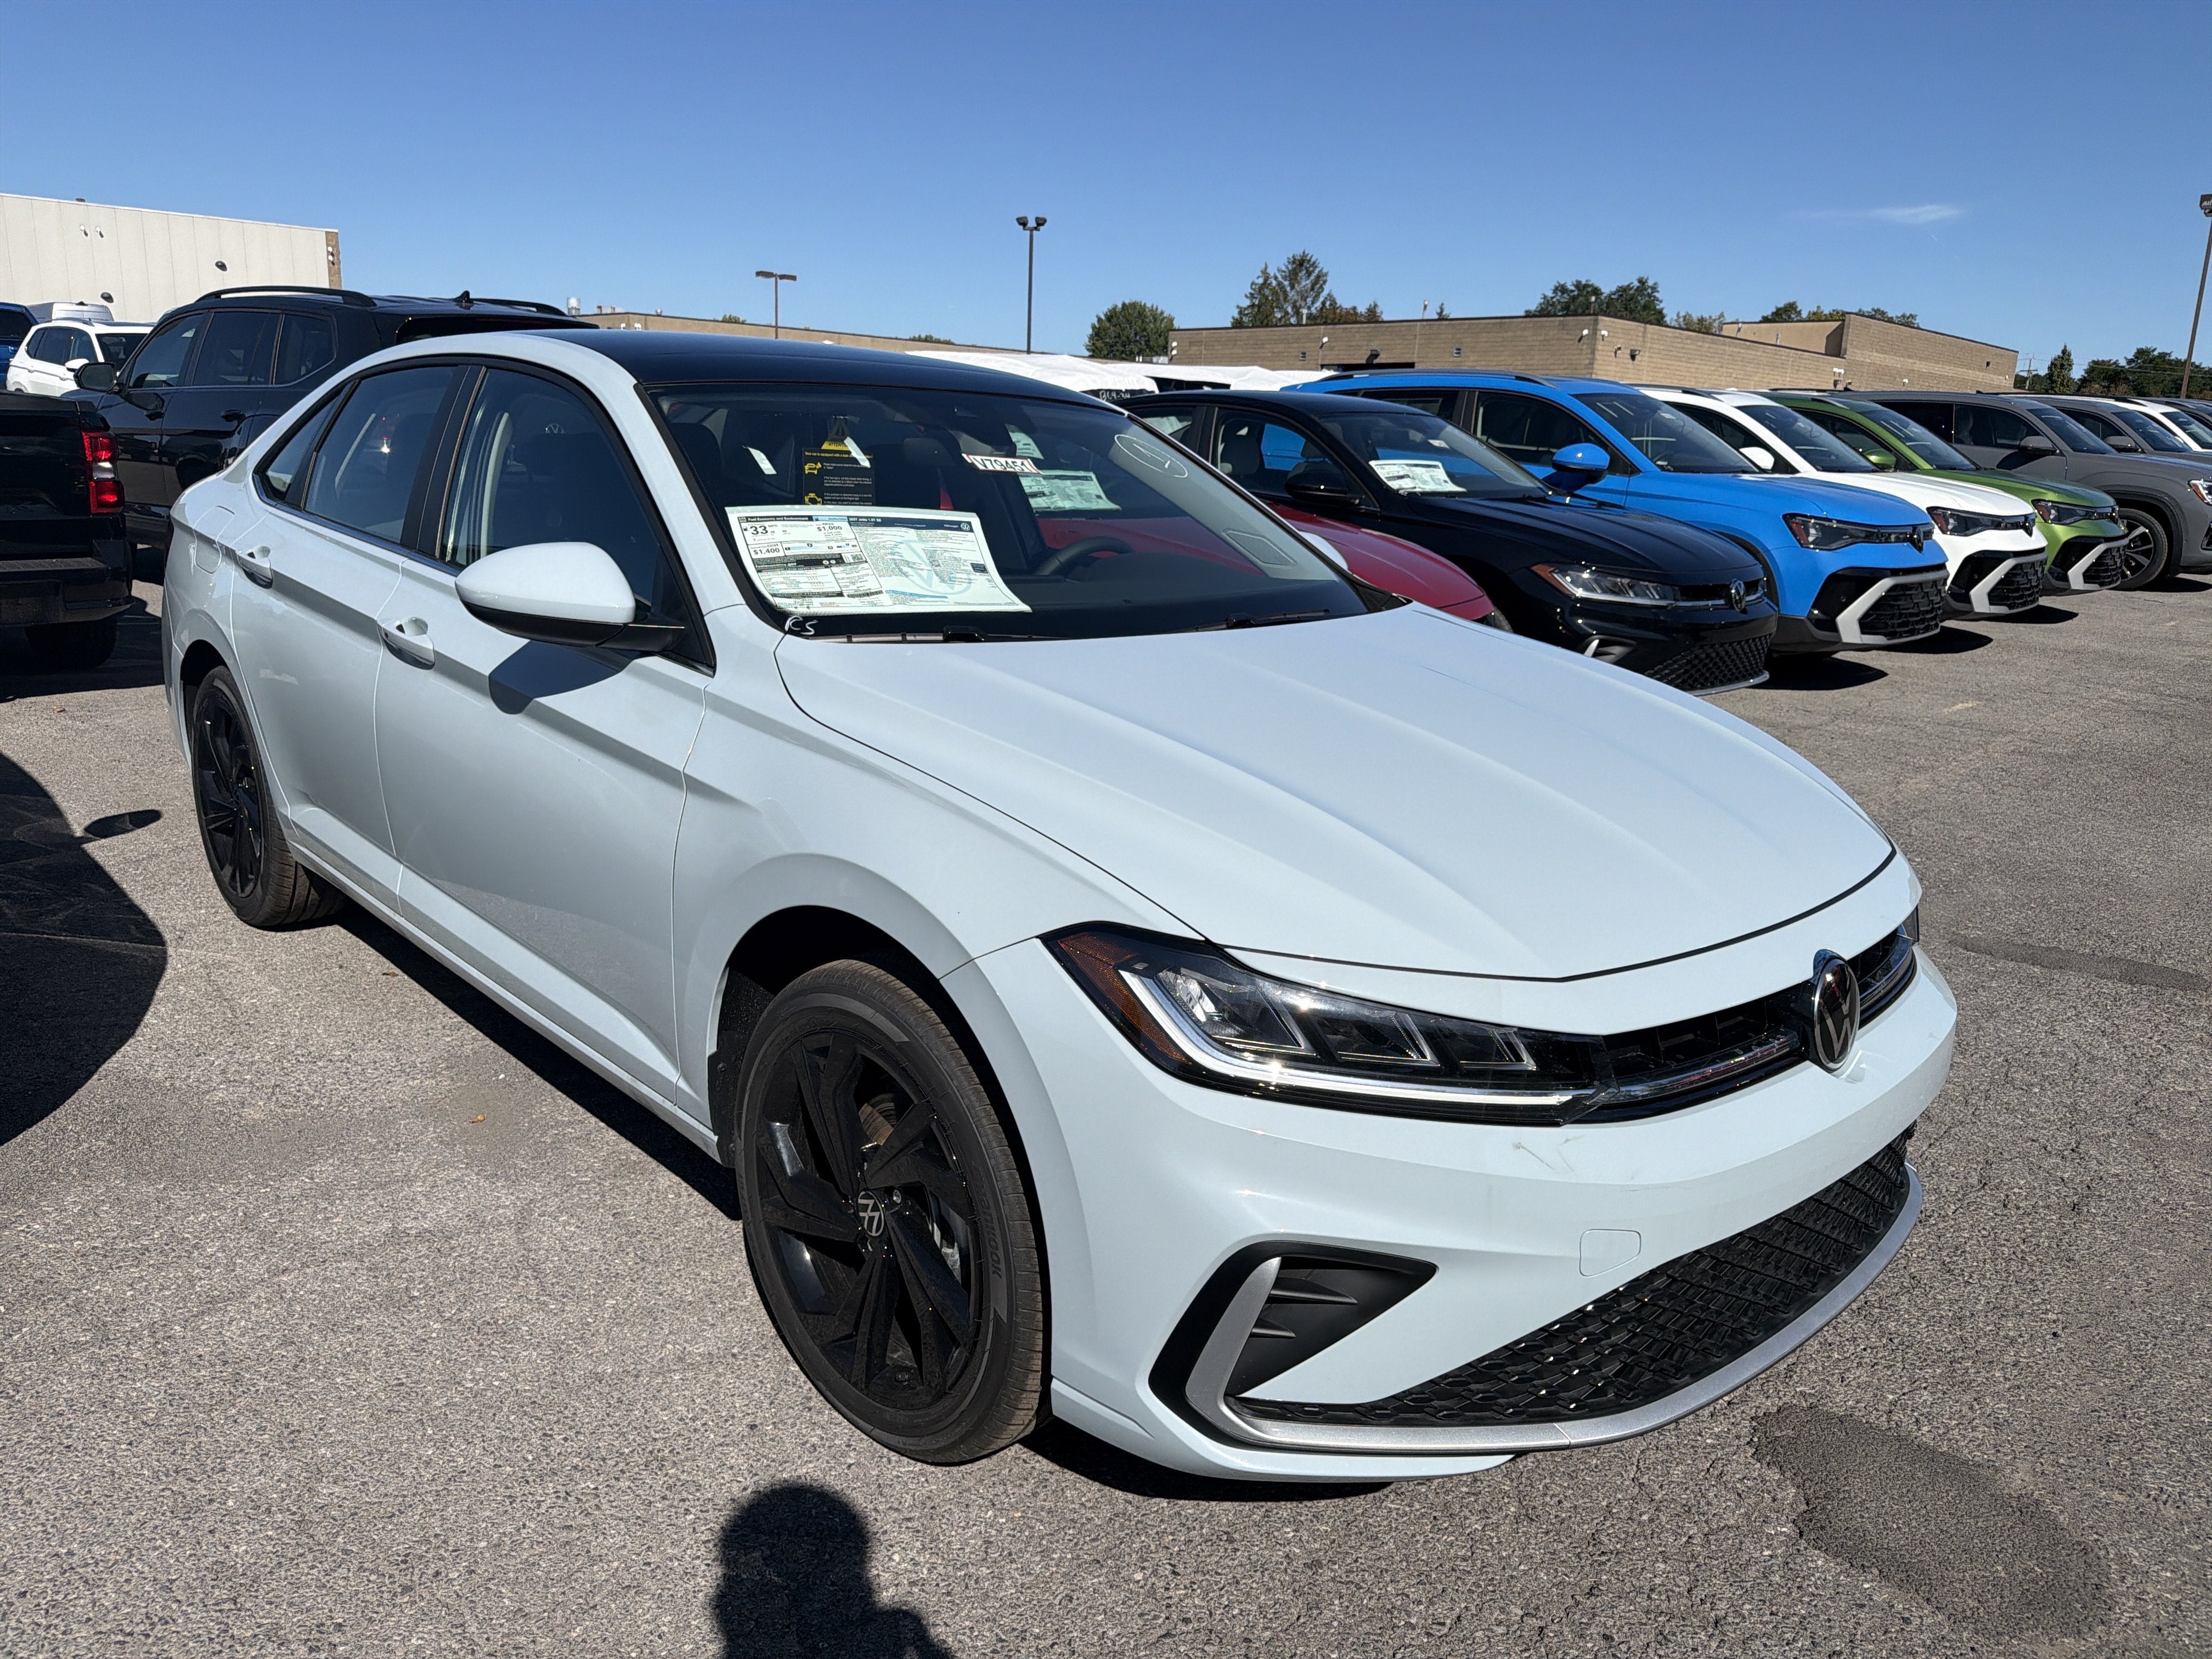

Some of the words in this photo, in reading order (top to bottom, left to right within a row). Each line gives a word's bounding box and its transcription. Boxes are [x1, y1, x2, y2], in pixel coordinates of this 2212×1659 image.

[973, 458, 1032, 472] V79451
[750, 525, 769, 535] 33
[753, 547, 780, 555] $1,400
